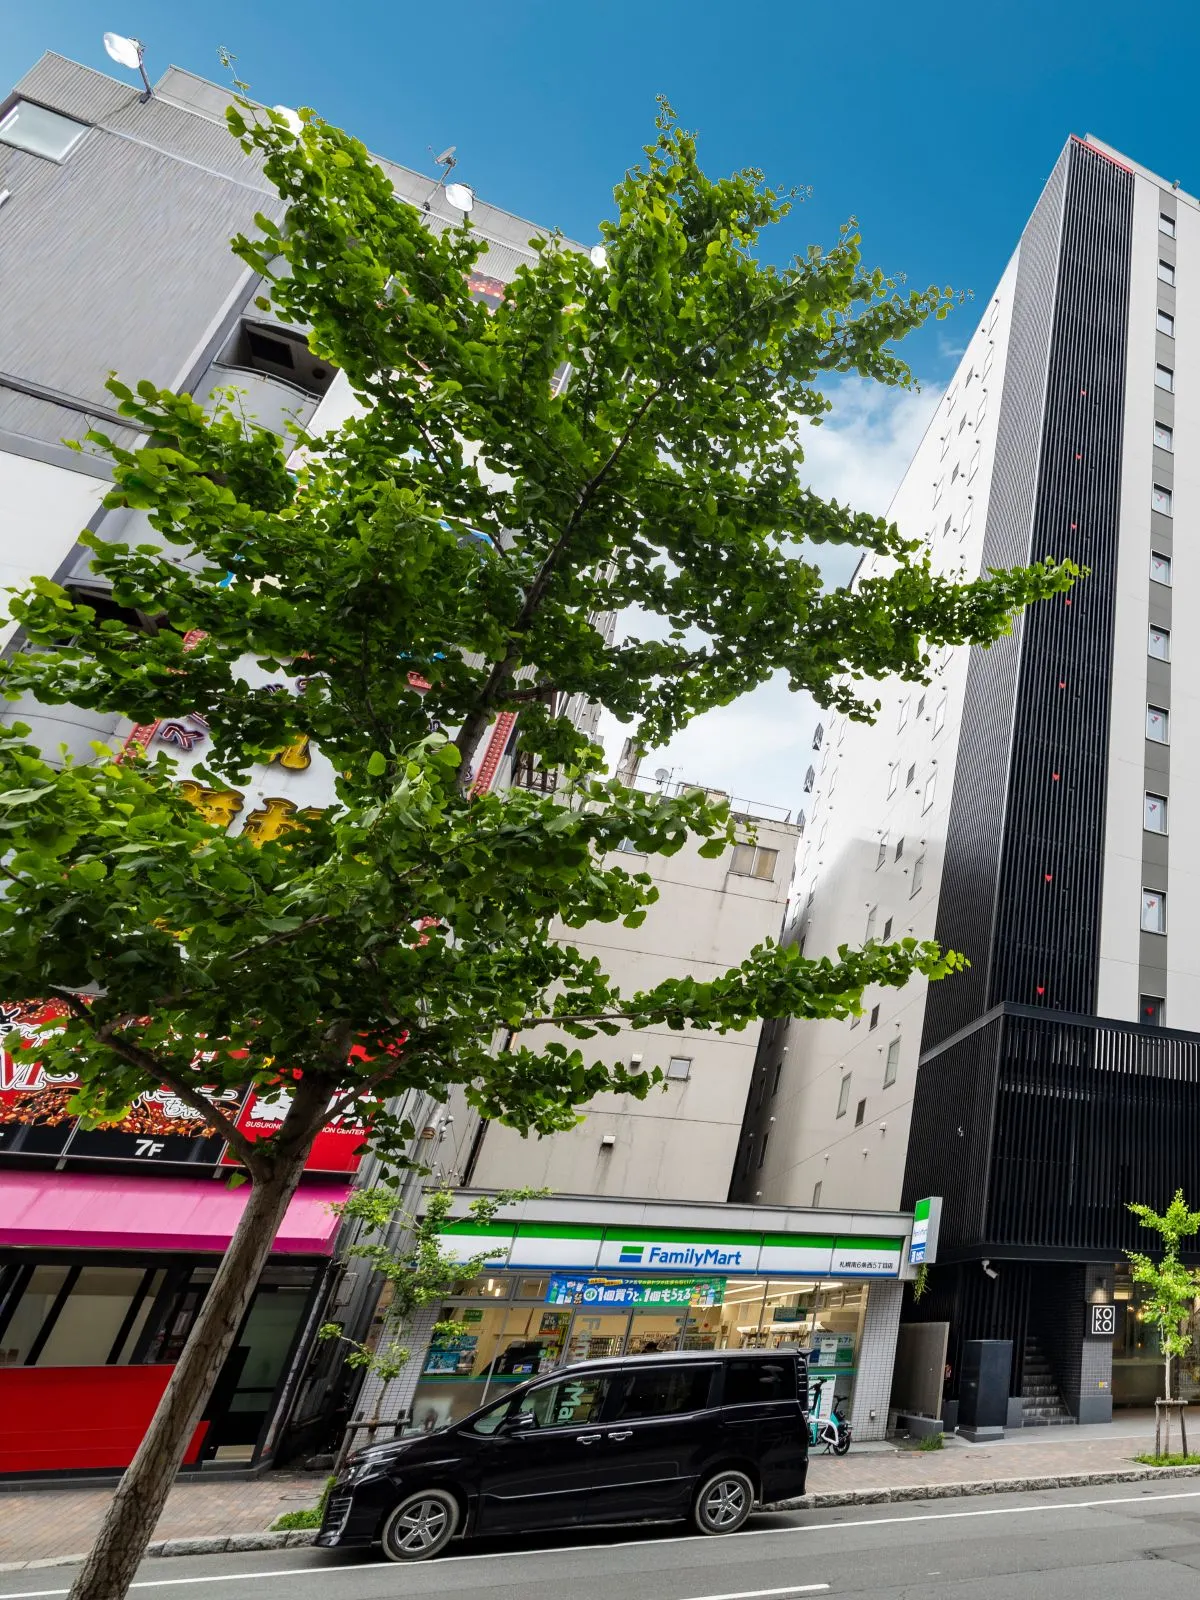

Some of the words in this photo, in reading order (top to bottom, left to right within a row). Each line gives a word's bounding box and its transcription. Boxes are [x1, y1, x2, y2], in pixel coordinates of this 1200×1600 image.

[134, 1138, 165, 1157] 7F
[648, 1246, 742, 1268] FamilyMart
[839, 1260, 894, 1270] 札幌南6条西5丁目店
[597, 1286, 692, 1303] 1個買うと、1個もらえる
[1096, 1308, 1112, 1320] KO
[1096, 1320, 1111, 1331] KO
